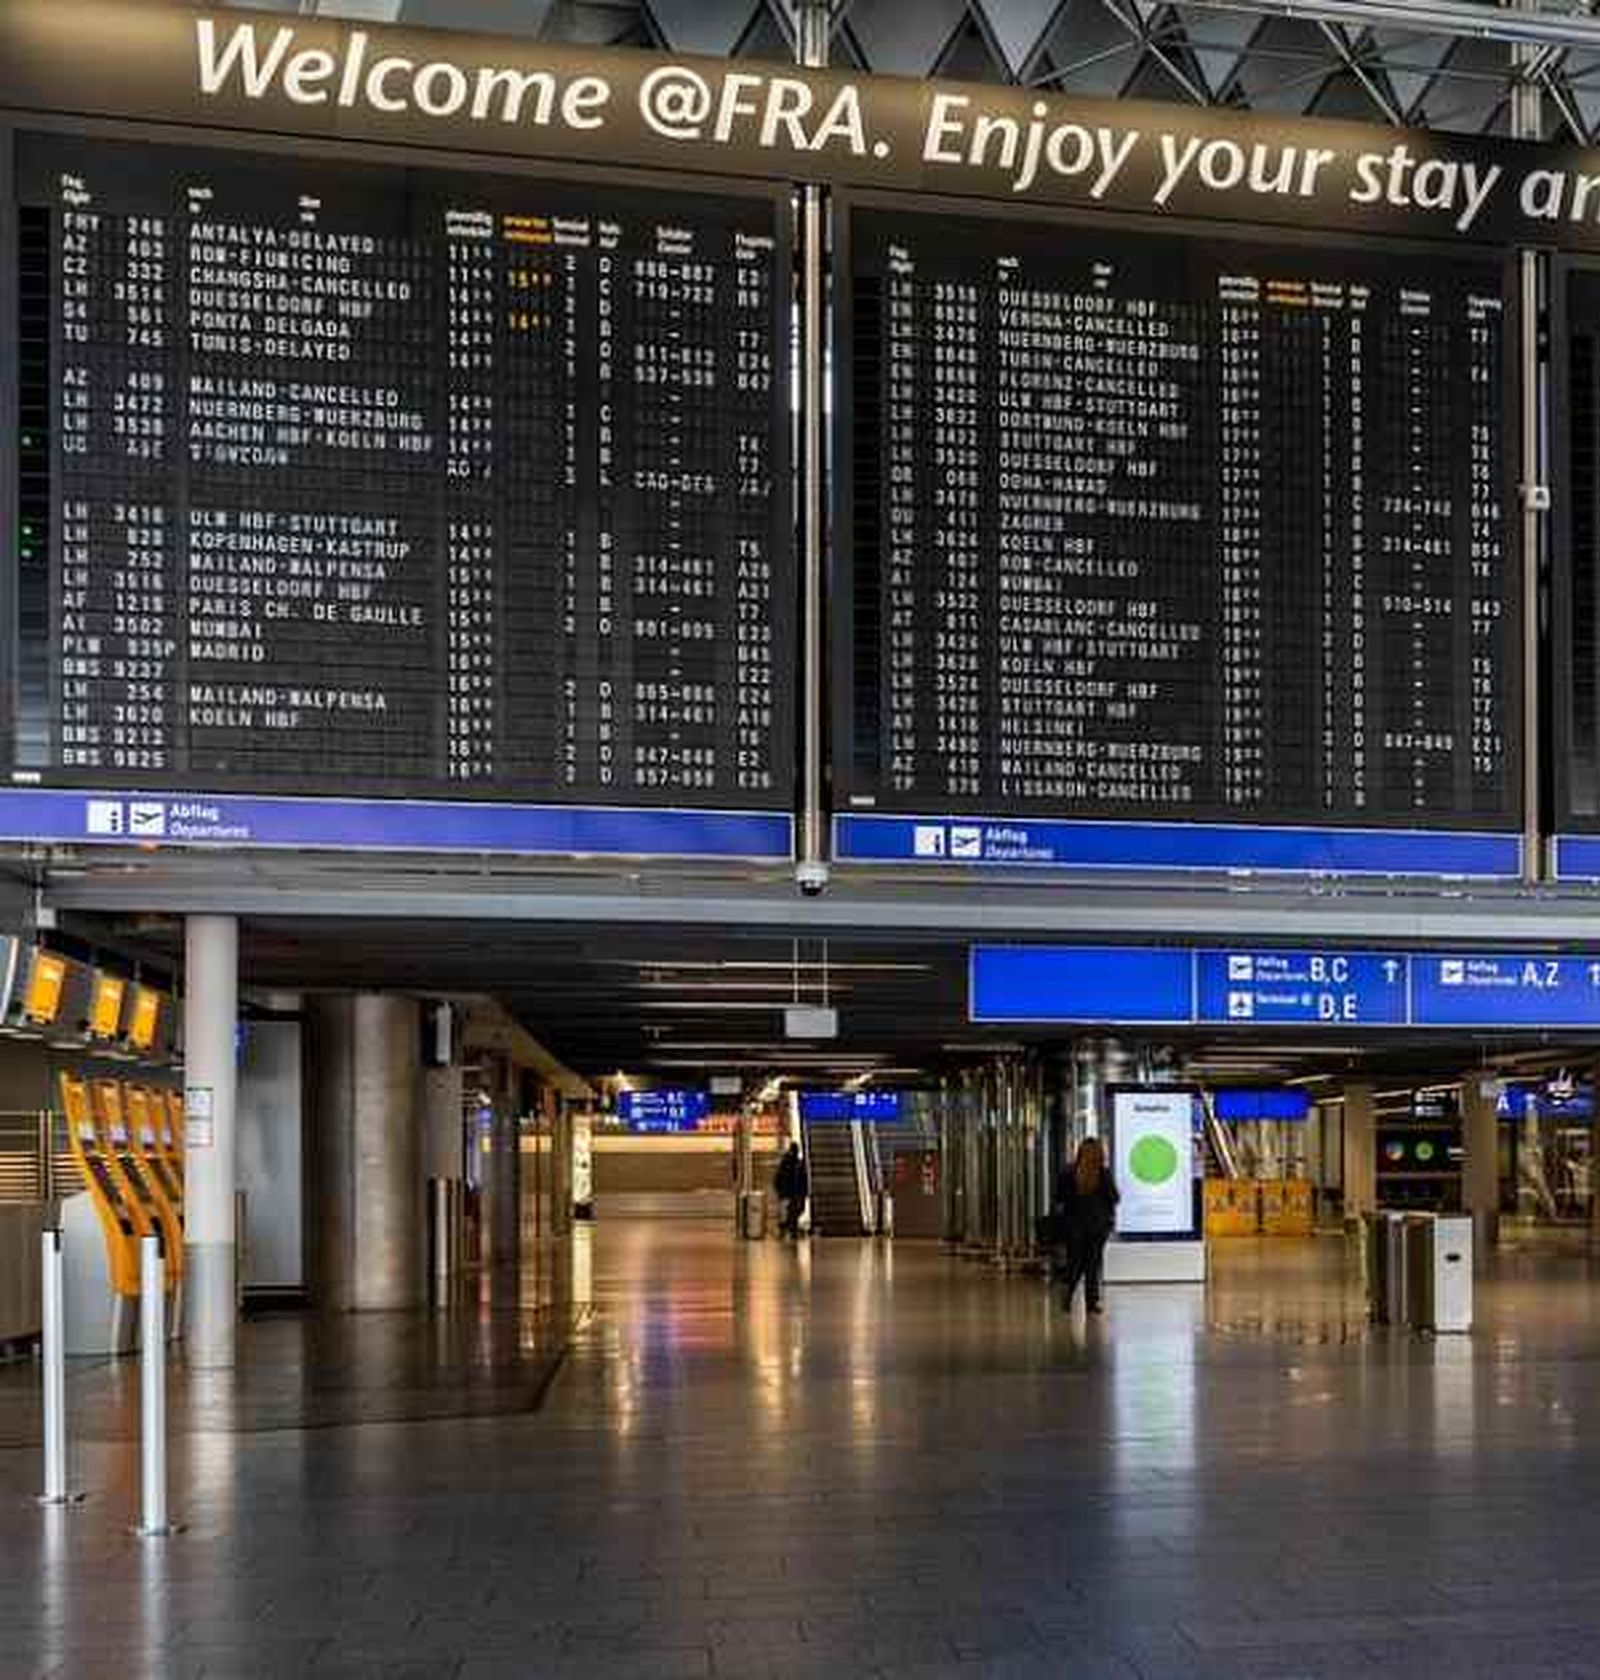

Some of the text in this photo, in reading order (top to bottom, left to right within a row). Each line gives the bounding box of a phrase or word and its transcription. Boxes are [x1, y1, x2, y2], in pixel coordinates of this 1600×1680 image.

[194, 19, 612, 128] Welcome
[638, 66, 890, 158] @FRA.
[924, 93, 1139, 197] Enjoy
[1155, 135, 1335, 203] your
[1351, 146, 1498, 228] stay
[170, 803, 219, 821] Abflug
[170, 821, 249, 838] Departures
[1310, 956, 1348, 983] B,C
[1522, 961, 1559, 987] A,Z
[1319, 993, 1357, 1021] D,E
